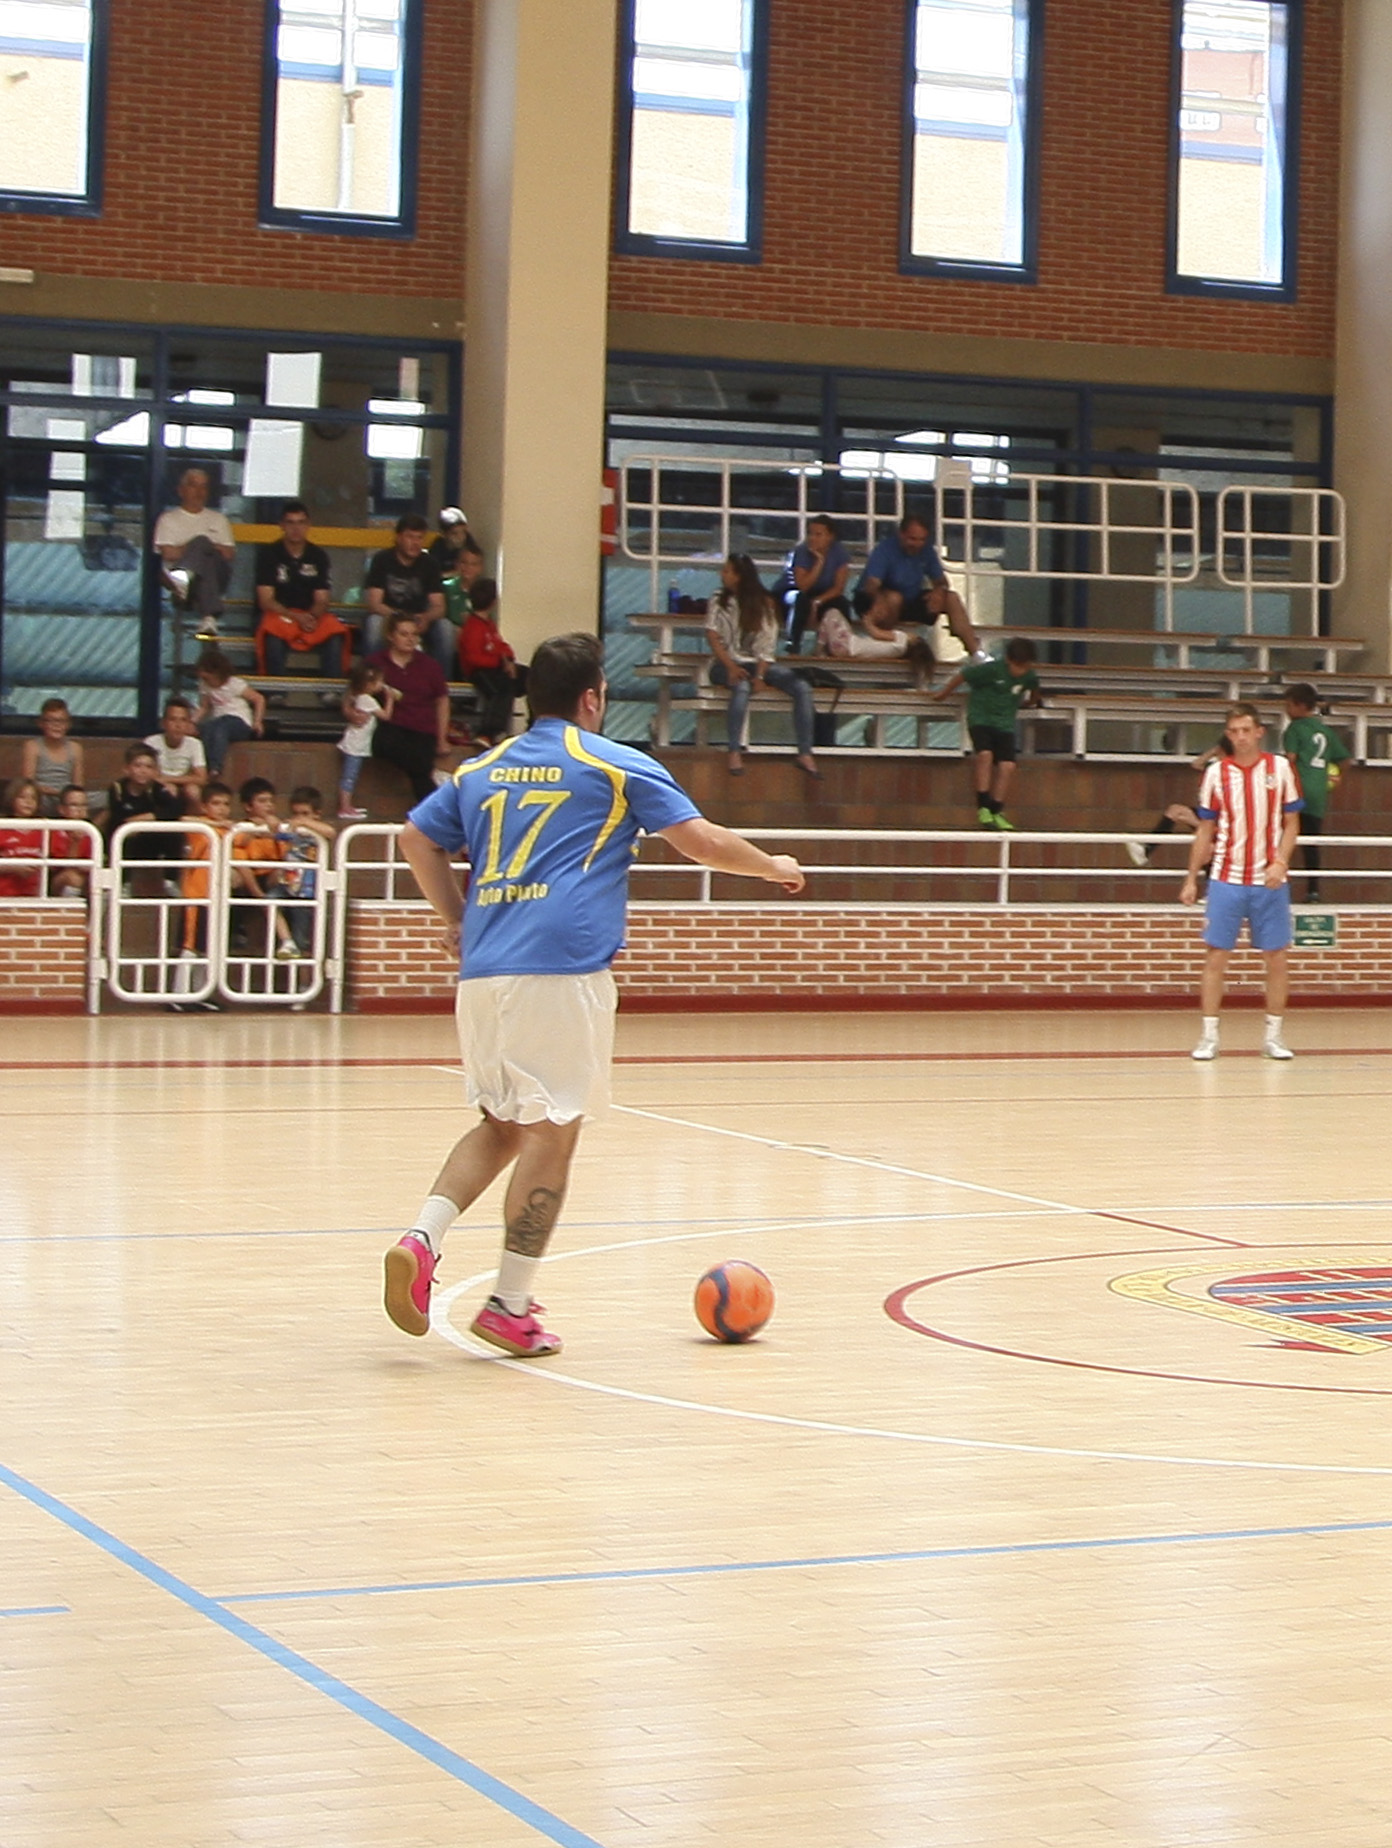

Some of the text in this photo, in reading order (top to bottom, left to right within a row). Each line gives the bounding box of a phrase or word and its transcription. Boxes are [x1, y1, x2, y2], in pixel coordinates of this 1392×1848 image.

[1311, 732, 1327, 768] 2
[489, 767, 563, 783] CHINO
[477, 789, 572, 886] 17
